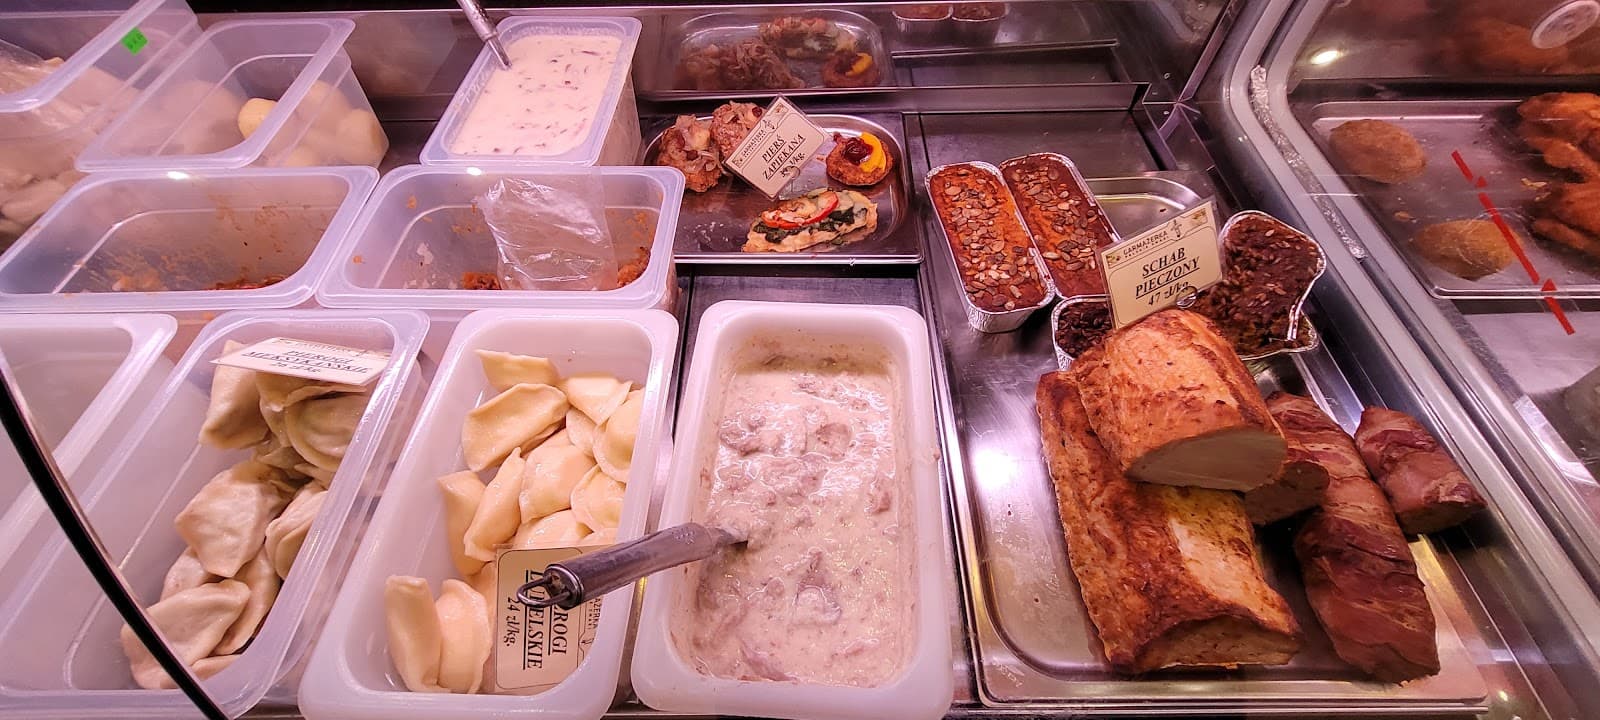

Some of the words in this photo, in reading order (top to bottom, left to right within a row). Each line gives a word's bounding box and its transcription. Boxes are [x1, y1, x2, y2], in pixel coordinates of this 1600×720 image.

[762, 134, 786, 162] PIERŚ
[763, 134, 805, 180] ZAPIEKANA
[1135, 256, 1200, 297] PIECZONY
[1142, 247, 1186, 277] SCHAB
[1148, 291, 1161, 306] 47
[507, 597, 521, 611] 24
[552, 603, 569, 655] ROGI
